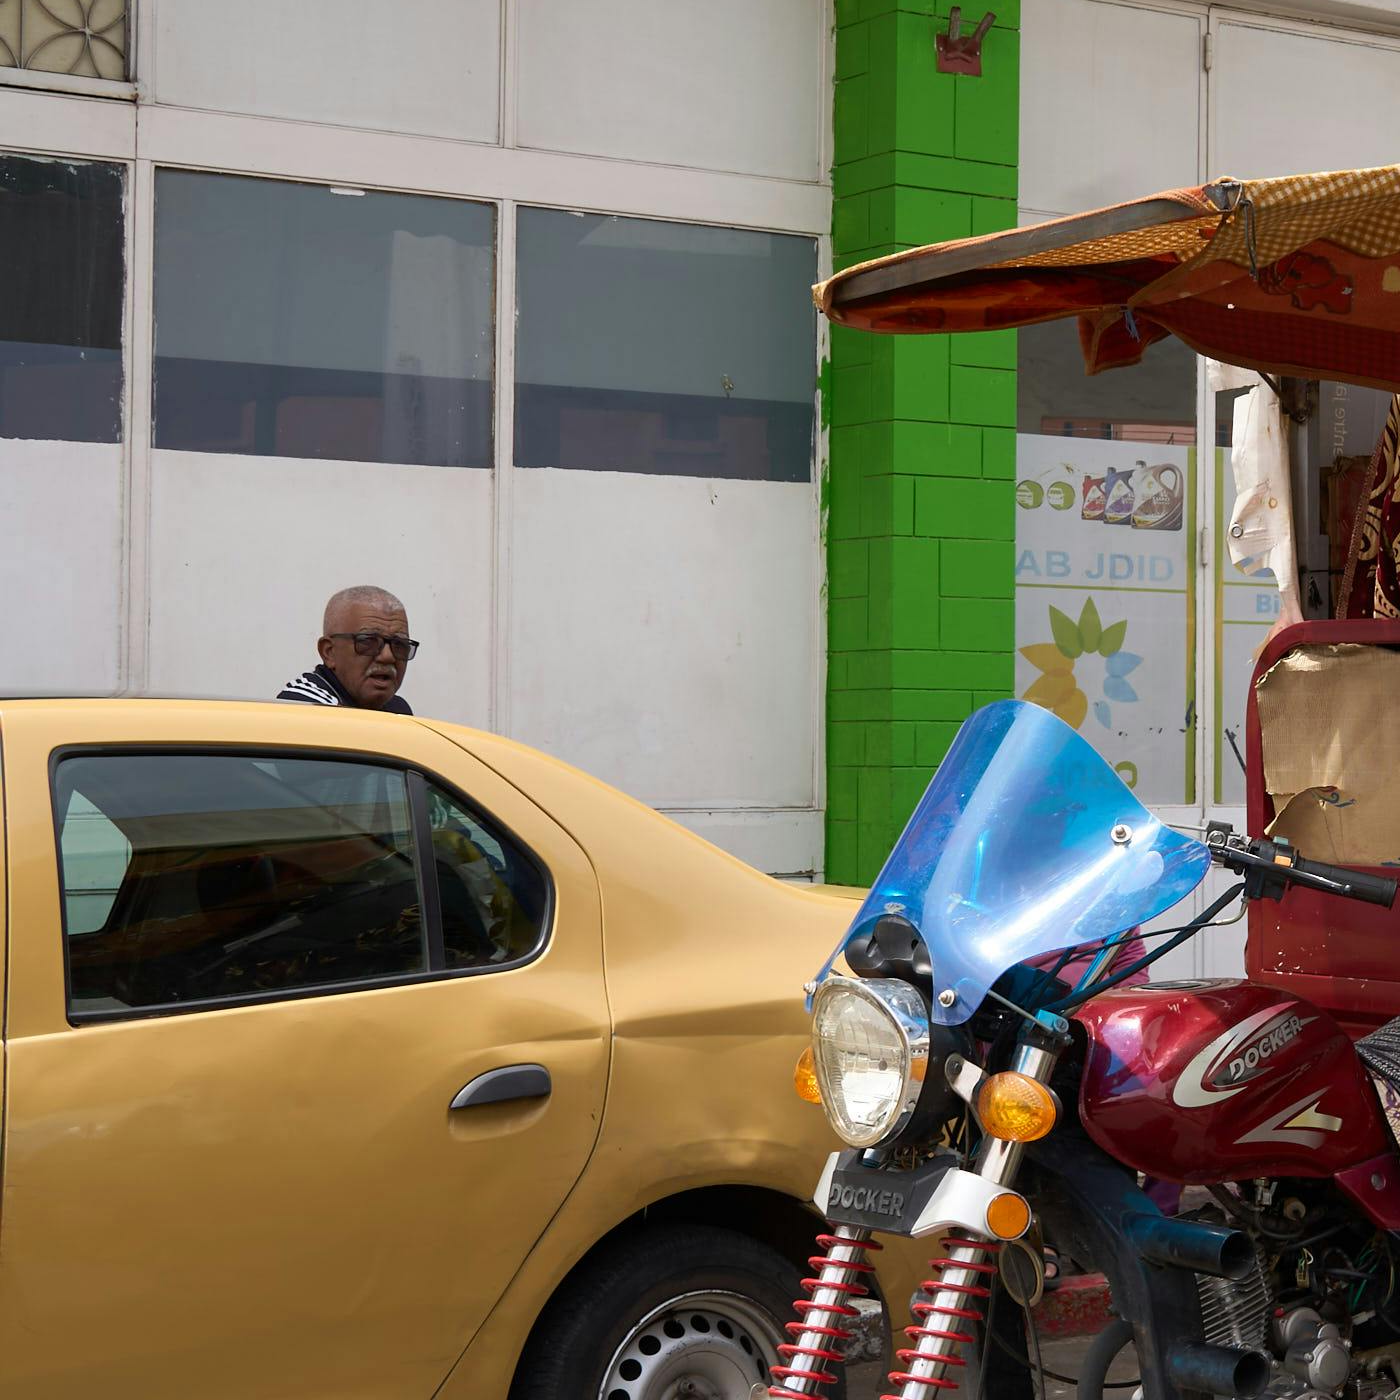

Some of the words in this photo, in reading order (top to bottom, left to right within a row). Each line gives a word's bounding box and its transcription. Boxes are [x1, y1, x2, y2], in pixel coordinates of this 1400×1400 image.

[1015, 549, 1071, 577] AB
[1085, 552, 1174, 581] JDID
[1229, 1015, 1302, 1080] DOCKER
[829, 1183, 904, 1216] DOCKER
